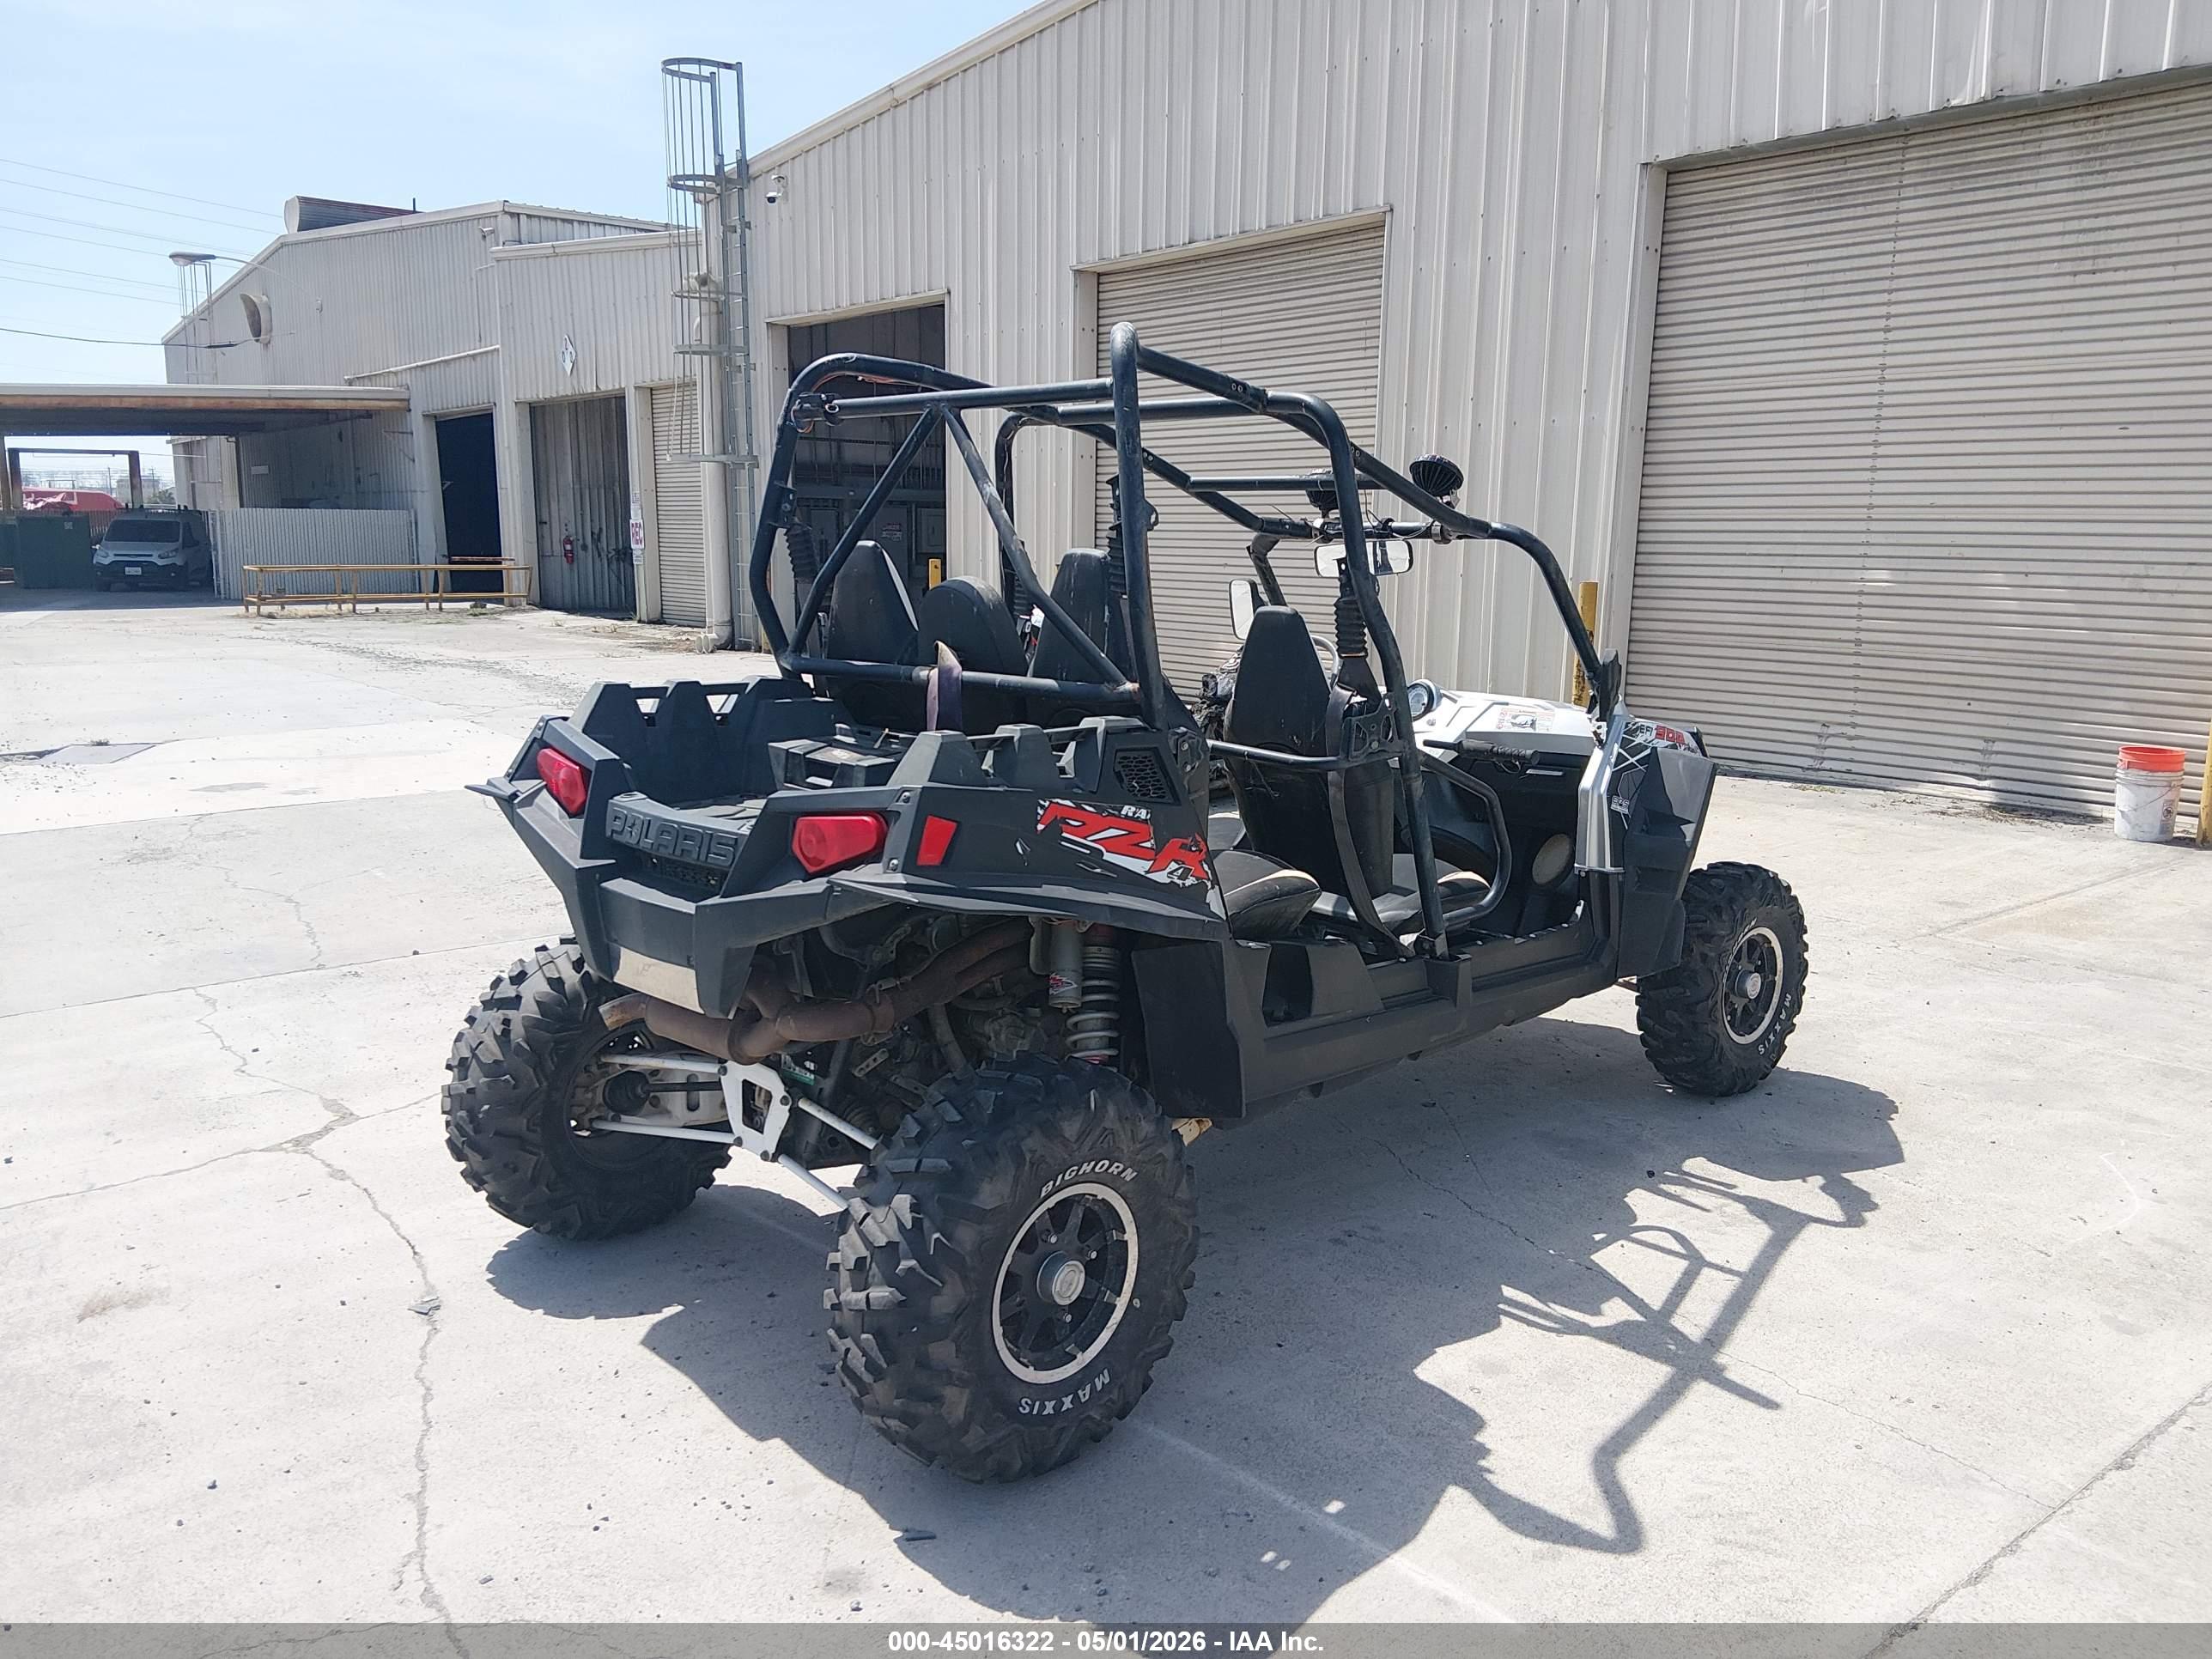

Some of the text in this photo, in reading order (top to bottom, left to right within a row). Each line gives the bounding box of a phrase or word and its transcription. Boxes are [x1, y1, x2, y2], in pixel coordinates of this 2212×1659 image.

[1121, 805, 1151, 819] RA
[605, 807, 738, 866] POLARIS
[1167, 865, 1194, 880] 4
[1758, 993, 1792, 1055] MAXXIS
[1040, 1159, 1139, 1199] BIGHORN
[1018, 1368, 1111, 1416] MAXXIS
